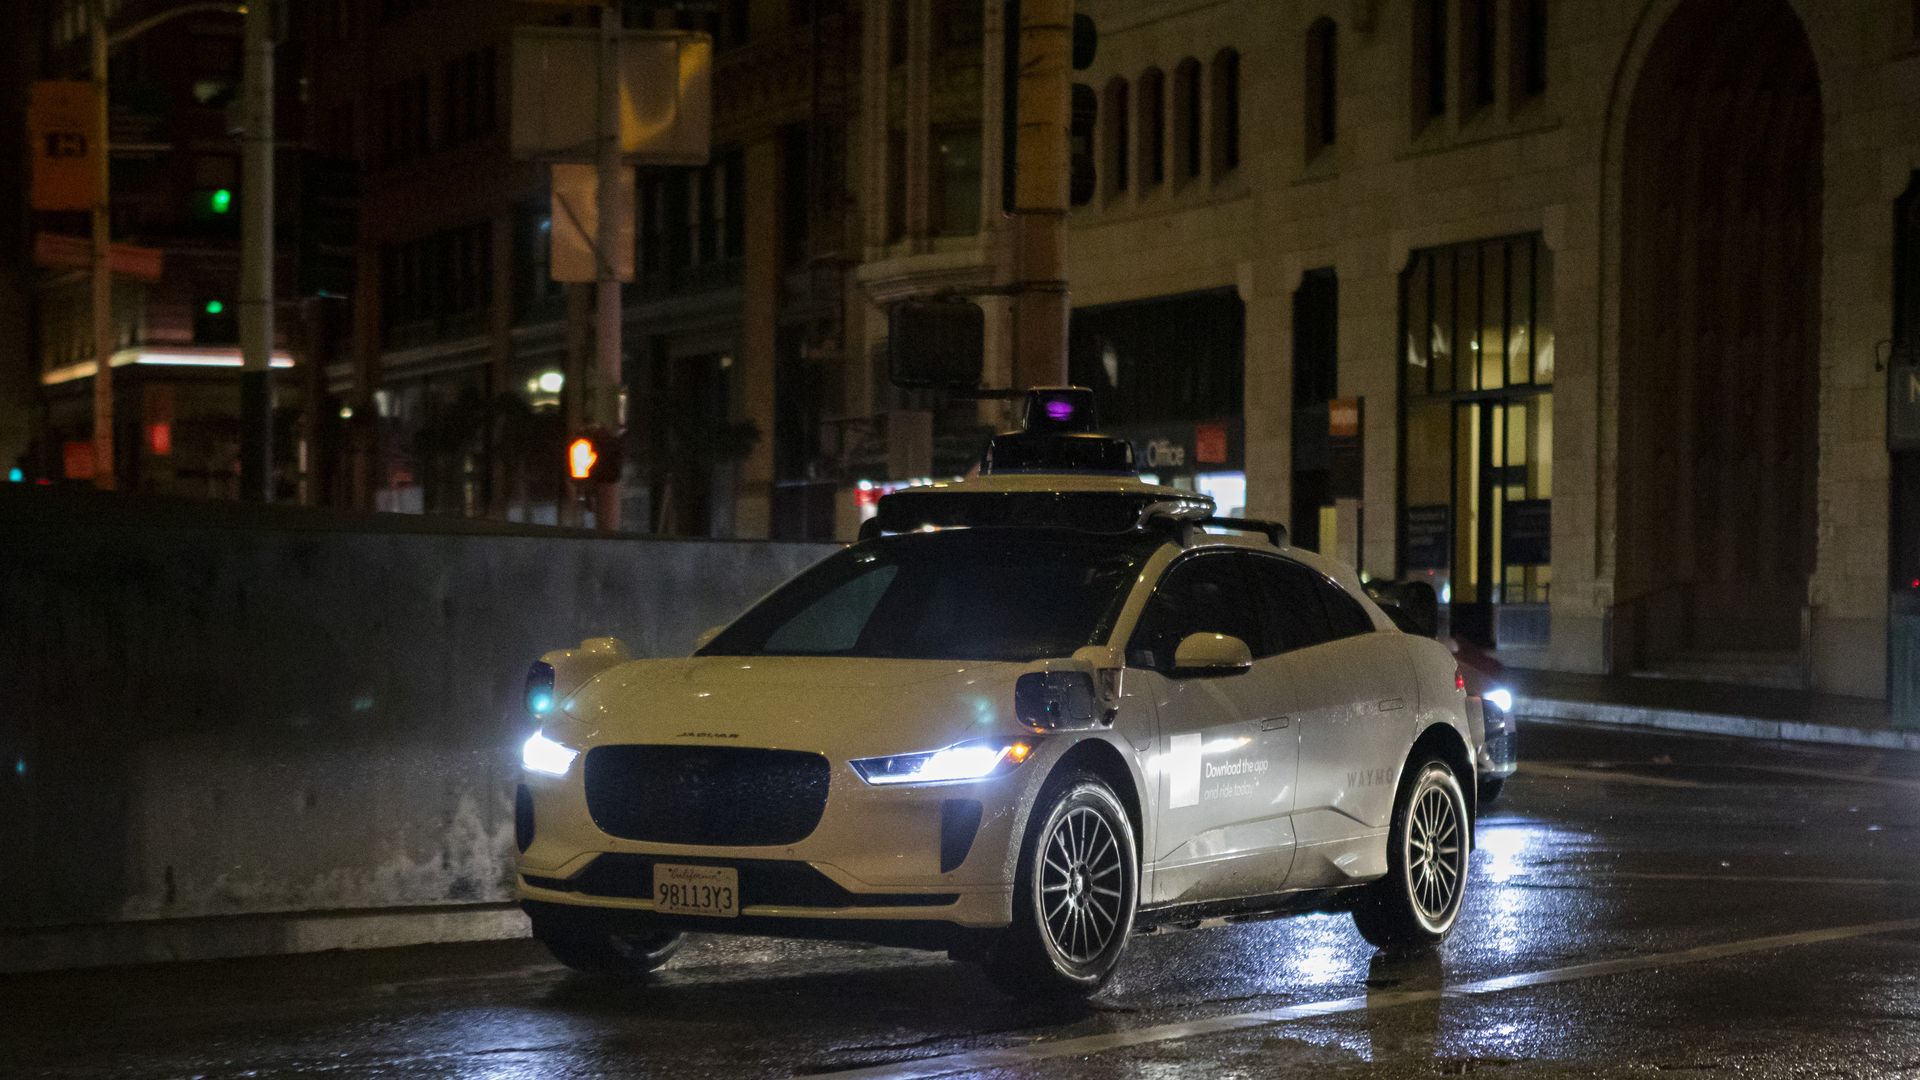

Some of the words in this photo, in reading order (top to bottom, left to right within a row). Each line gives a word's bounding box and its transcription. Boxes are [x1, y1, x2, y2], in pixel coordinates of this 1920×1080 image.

[1205, 758, 1242, 779] Download
[1242, 758, 1254, 774] the
[1254, 759, 1269, 775] app
[1347, 767, 1394, 788] WAYMO
[1204, 783, 1219, 801] and
[1219, 782, 1233, 799] ride
[659, 882, 733, 910] 98113Y3
